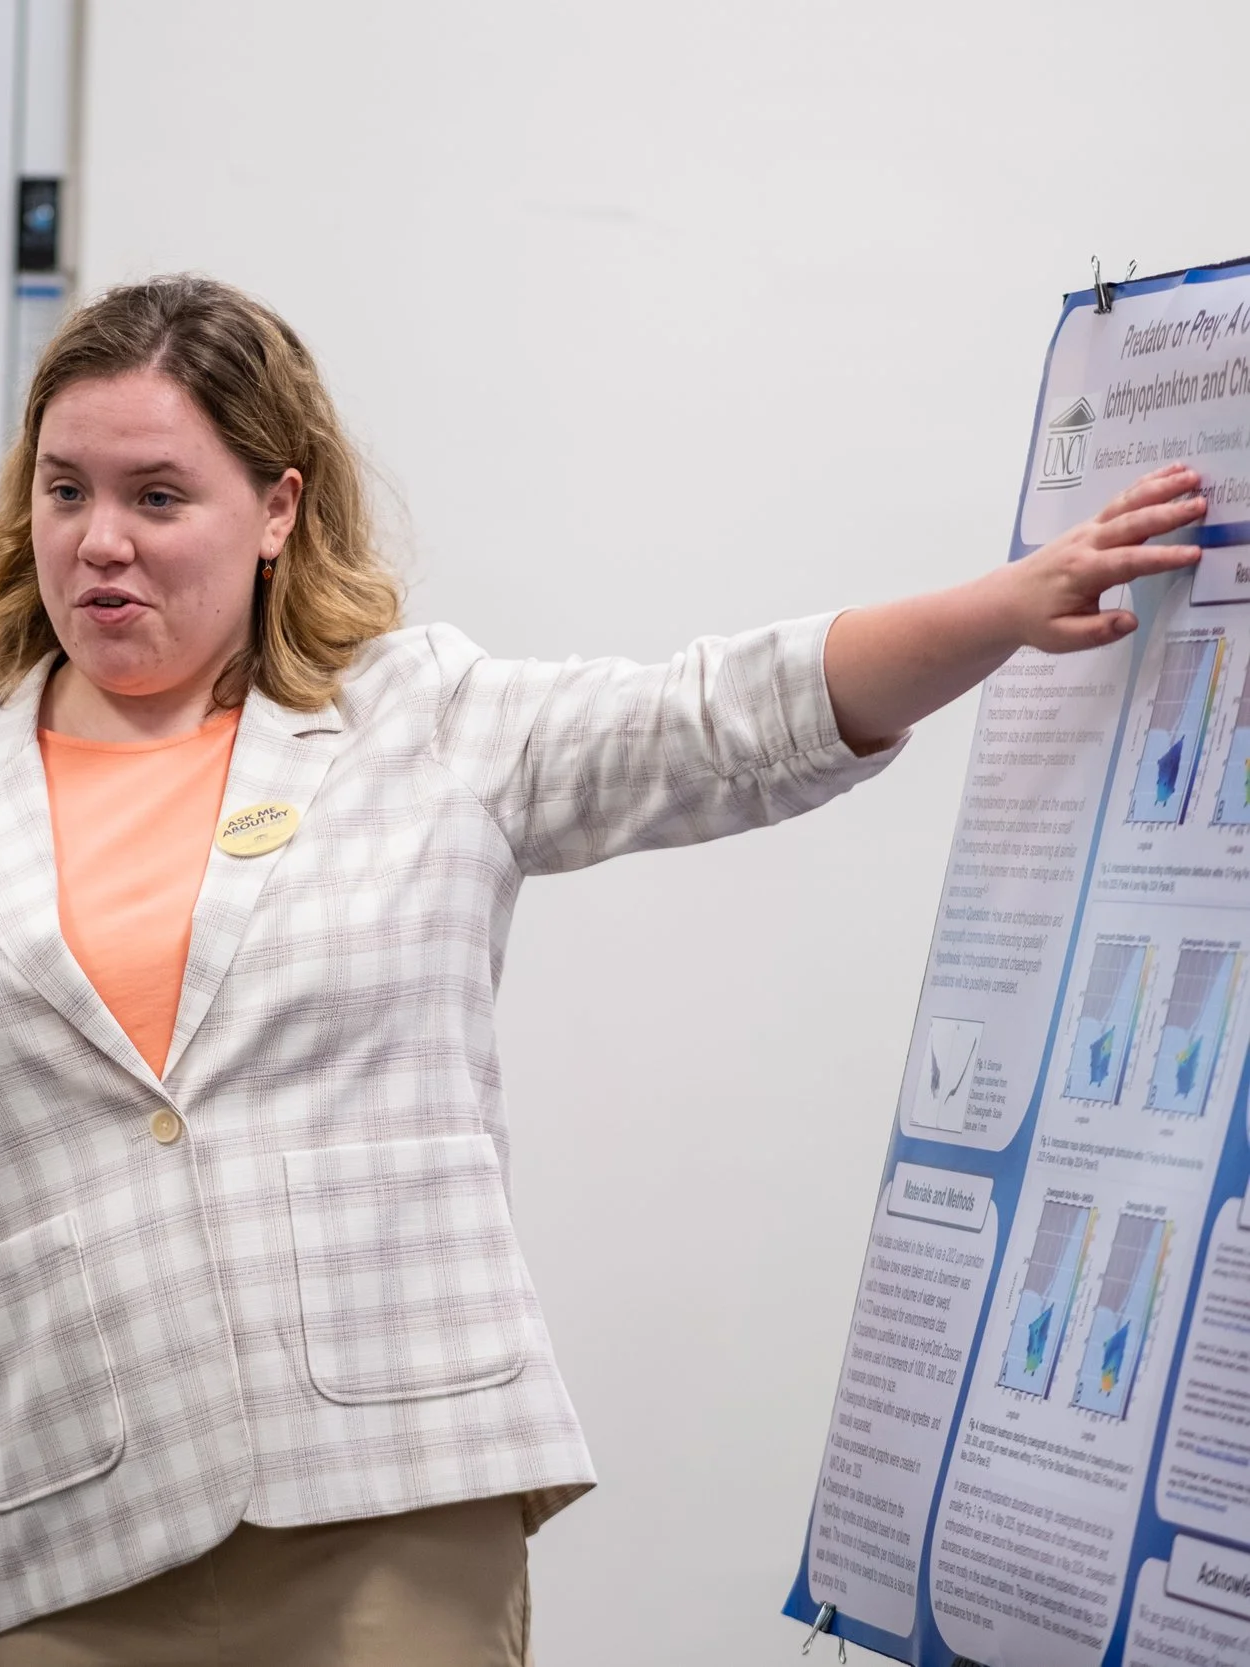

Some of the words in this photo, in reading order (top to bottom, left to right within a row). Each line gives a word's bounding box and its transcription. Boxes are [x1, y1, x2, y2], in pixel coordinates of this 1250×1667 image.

[1120, 319, 1174, 360] Predator
[1172, 320, 1191, 348] or
[1225, 302, 1244, 337] A
[1103, 369, 1198, 424] Ichthyoplankton
[1201, 359, 1228, 401] and
[1235, 562, 1250, 585] Res
[222, 816, 266, 837] ABOUT
[269, 809, 289, 820] MY
[228, 813, 254, 828] ASK
[257, 806, 276, 817] ME
[903, 1178, 932, 1204] Materials
[932, 1185, 946, 1206] and
[945, 1187, 976, 1212] Methods
